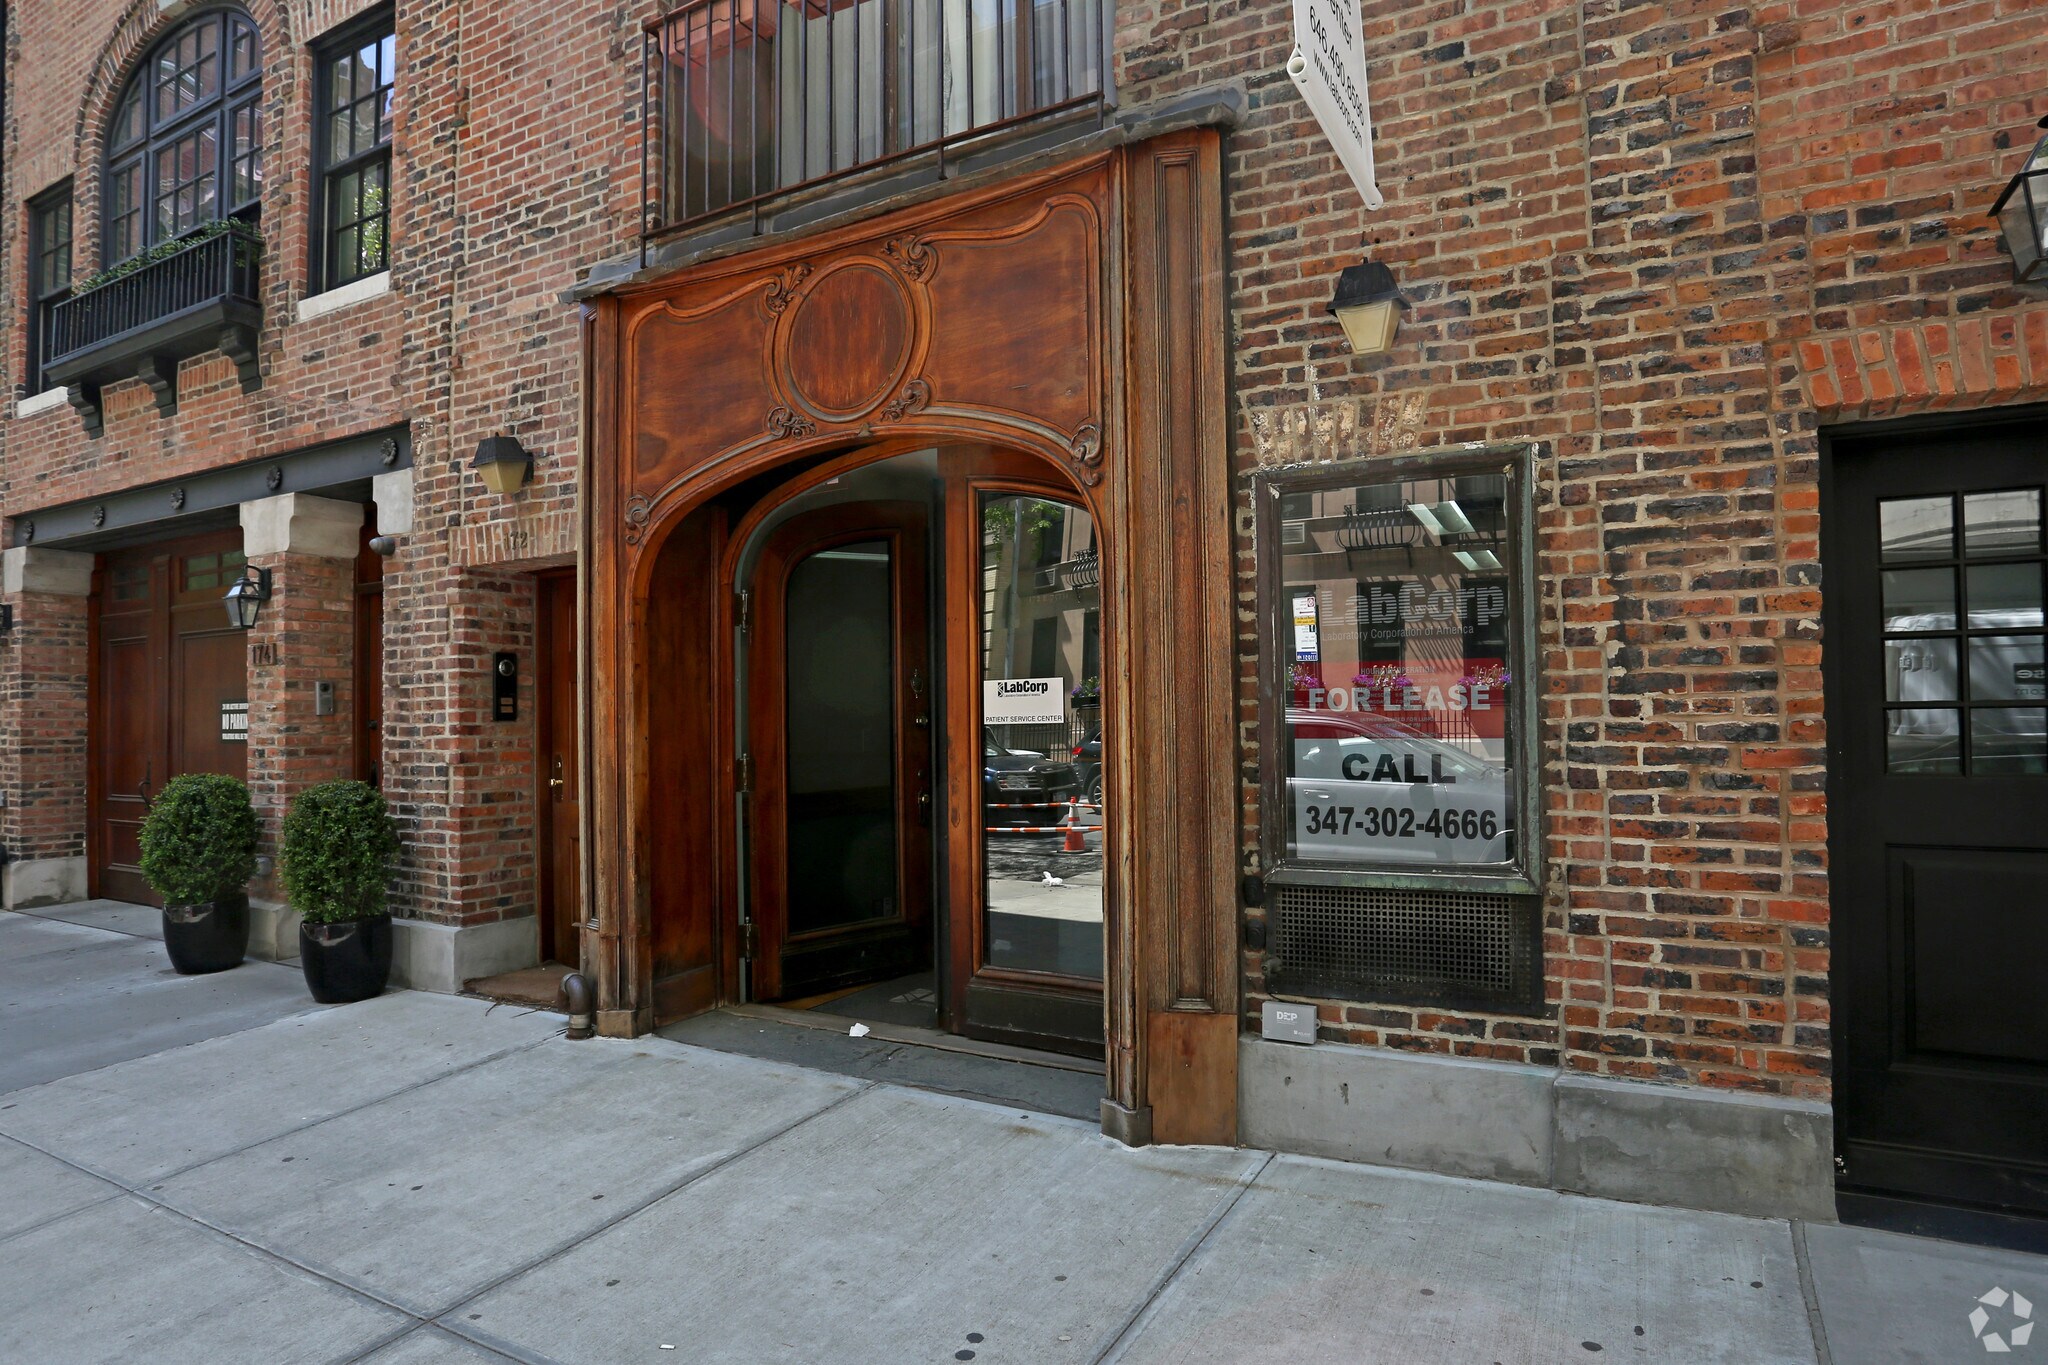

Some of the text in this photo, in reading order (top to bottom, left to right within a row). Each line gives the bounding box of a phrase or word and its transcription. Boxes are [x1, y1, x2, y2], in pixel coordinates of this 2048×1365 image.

[1326, 0, 1352, 51] enter
[1313, 48, 1363, 149] www.labcorp.com
[504, 531, 528, 551] 172
[1320, 581, 1505, 627] LabCorp
[1322, 630, 1368, 642] Laboratory
[1370, 627, 1422, 640] Corporation
[1424, 626, 1434, 637] of
[1436, 624, 1475, 636] America
[1004, 680, 1049, 694] LabCorp
[1308, 686, 1371, 713] FOR
[1383, 685, 1491, 712] LEASE
[1037, 714, 1062, 722] CENTER
[1341, 753, 1456, 784] CALL
[1305, 805, 1497, 840] 347-302-4666
[1276, 1010, 1298, 1021] DEP
